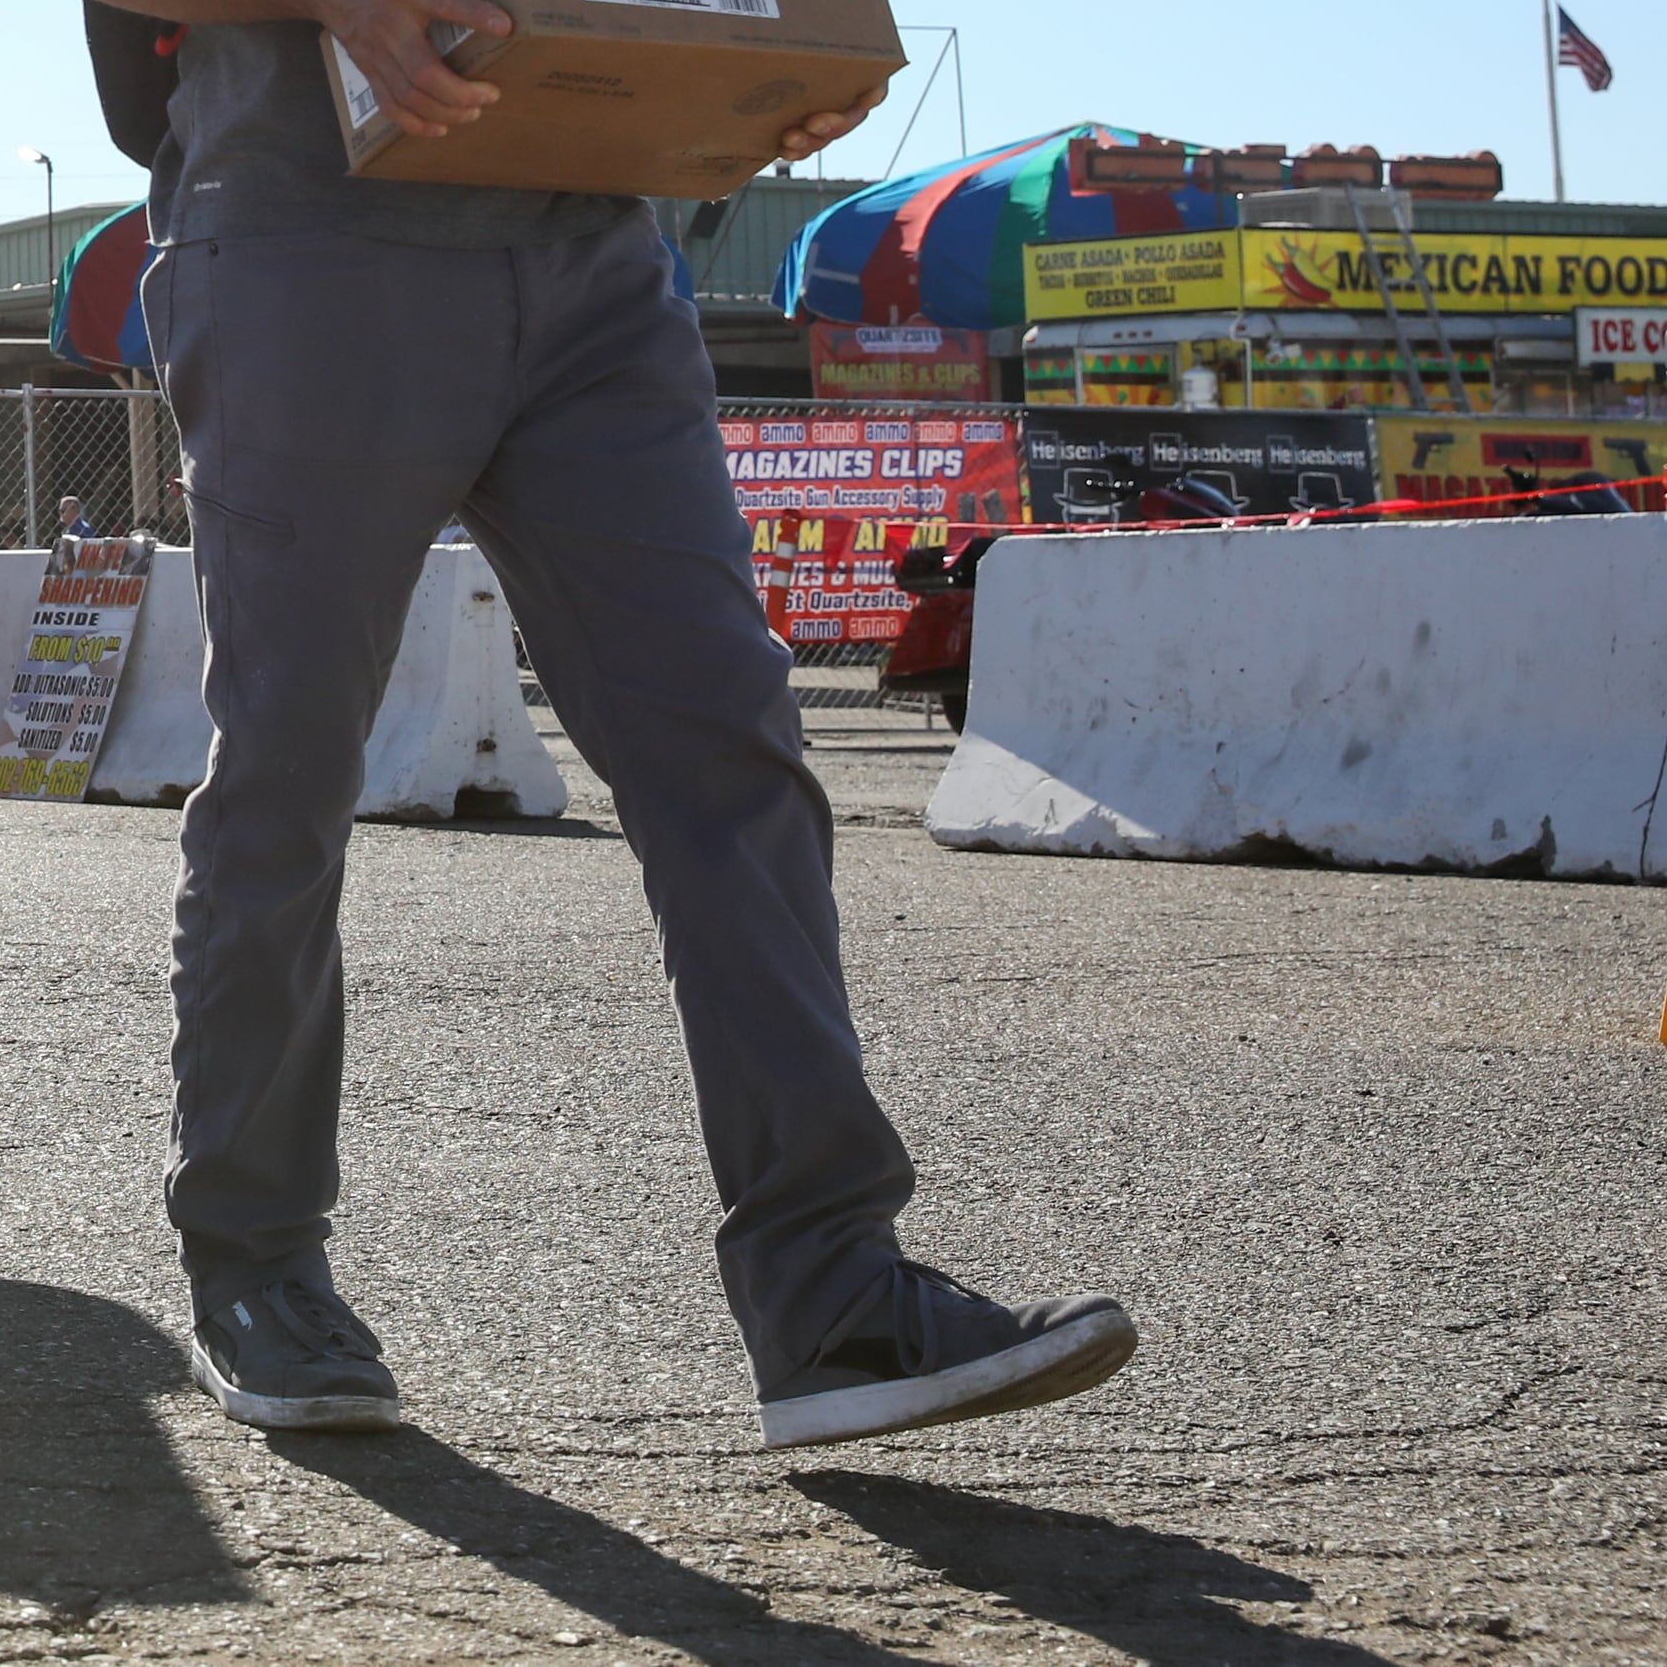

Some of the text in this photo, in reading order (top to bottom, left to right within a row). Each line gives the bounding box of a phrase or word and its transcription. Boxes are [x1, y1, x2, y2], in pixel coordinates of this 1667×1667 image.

[1134, 244, 1175, 266] POLLO
[1180, 241, 1225, 261] ASADA
[1336, 250, 1667, 298] MEXICAN FOOD
[1085, 289, 1133, 310] GREEN
[858, 329, 940, 344] QUARZSITE
[1591, 318, 1637, 353] ICE
[821, 363, 980, 384] MAGAZINES & CLIPS
[760, 423, 805, 443] ammo
[812, 423, 858, 443] ammo
[865, 422, 909, 442] ammo
[915, 422, 955, 442] ammo
[962, 422, 1004, 441] ammo
[880, 449, 964, 478] CLIPS
[1154, 441, 1263, 467] Heisenberg
[1270, 443, 1366, 469] Heisenberg
[735, 485, 945, 509] Quartzsite Gun Accessory Supply
[39, 576, 144, 608] SHARPENING
[809, 589, 912, 611] Quartzsite,
[33, 612, 99, 626] INSIDE
[791, 617, 898, 639] ammo ammo
[28, 635, 73, 662] FROM
[34, 675, 87, 695] ULTRASONIC
[87, 677, 114, 697] $5.00
[26, 701, 106, 725] SOLUTIONS $5.00
[18, 728, 98, 752] SANITIZED $5.00
